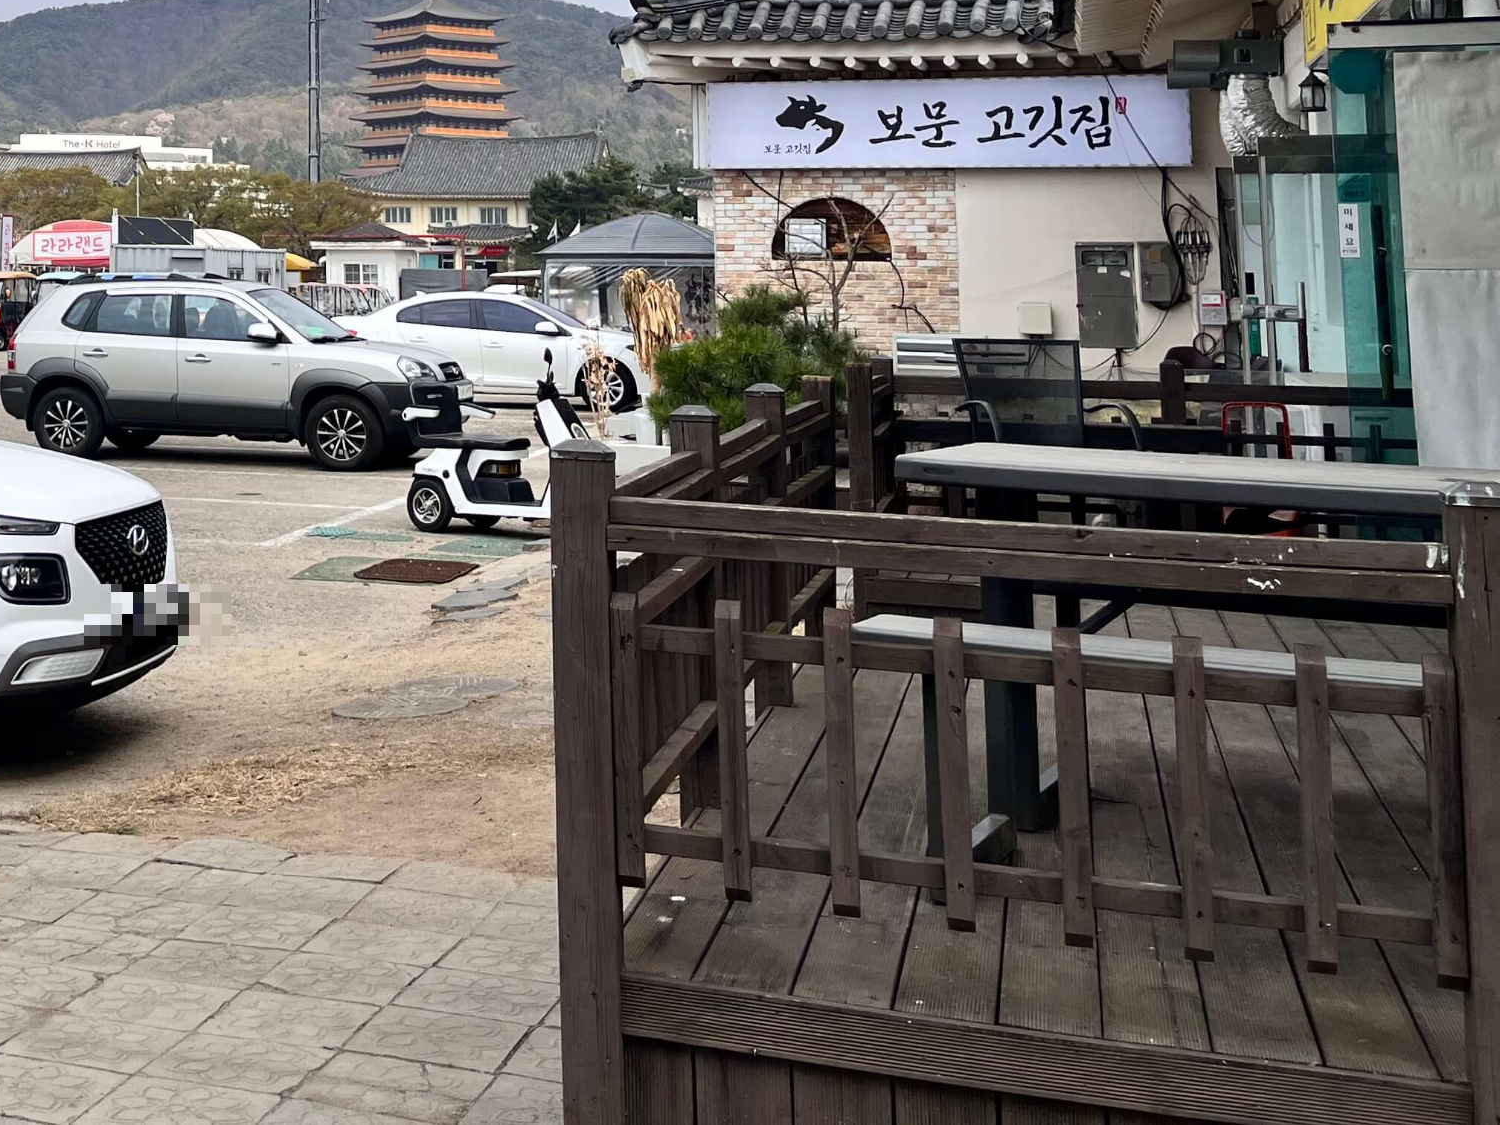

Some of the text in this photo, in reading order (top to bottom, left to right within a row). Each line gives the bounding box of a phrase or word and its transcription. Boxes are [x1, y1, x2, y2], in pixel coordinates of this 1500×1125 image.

[868, 95, 1112, 150] 보문 고깃집
[96, 140, 121, 149] Hotel
[763, 142, 812, 155] 보문 고깃집
[1343, 207, 1355, 246] 미세요
[41, 235, 105, 255] 라라랜드
